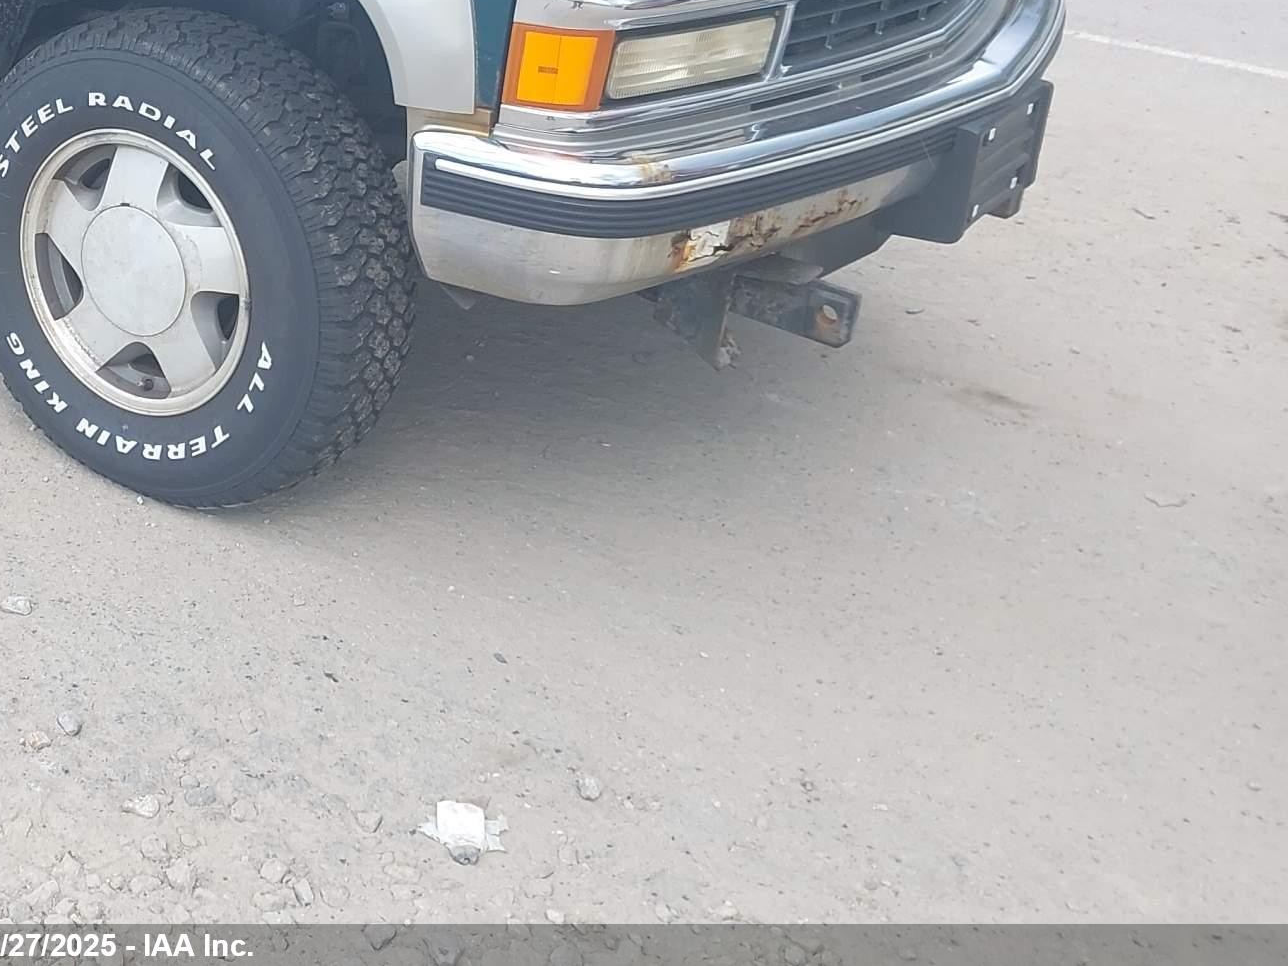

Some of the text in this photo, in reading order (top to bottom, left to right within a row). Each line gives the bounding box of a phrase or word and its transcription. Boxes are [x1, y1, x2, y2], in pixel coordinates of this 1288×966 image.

[87, 91, 216, 171] RADIAL
[5, 331, 273, 461] ALL TERRAIN KING
